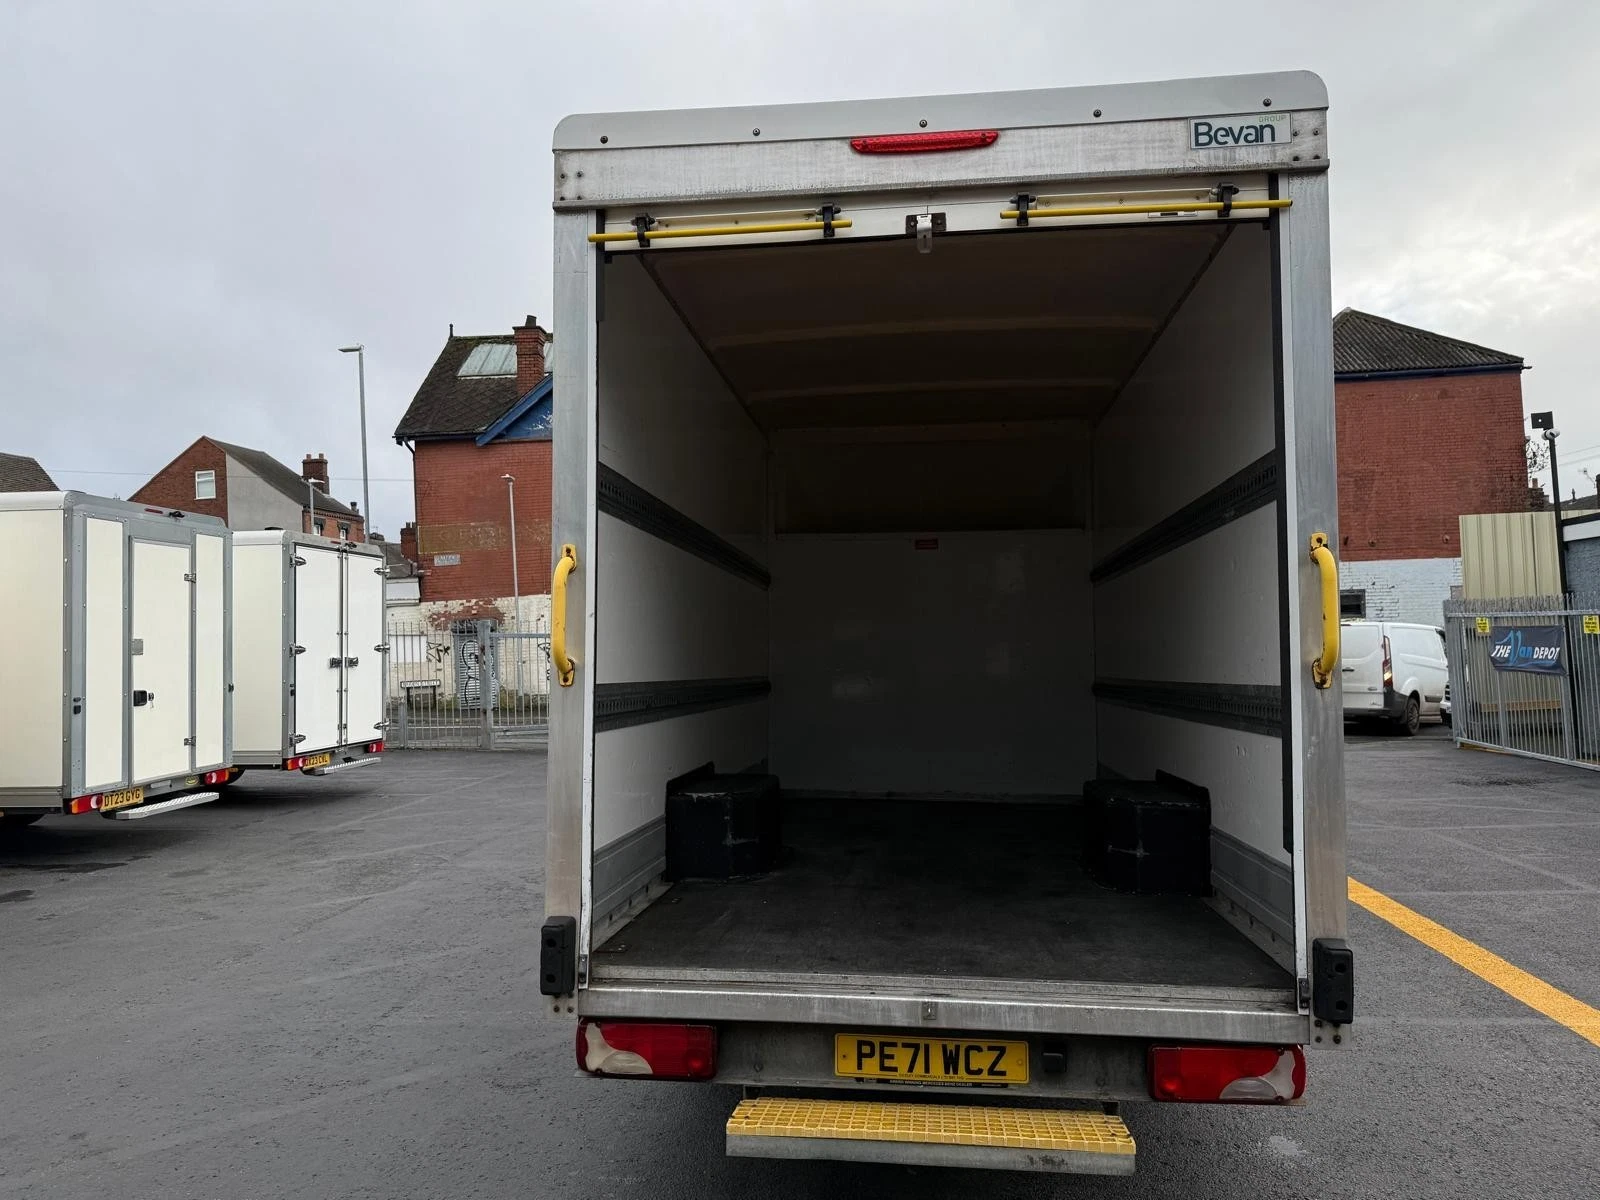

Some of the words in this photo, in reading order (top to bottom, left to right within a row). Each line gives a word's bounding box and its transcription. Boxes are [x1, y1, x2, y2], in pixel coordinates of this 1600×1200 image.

[1259, 114, 1287, 123] GROUP
[1194, 121, 1276, 147] Bevan
[1491, 645, 1511, 658] THE
[1533, 647, 1560, 660] DEPOT
[104, 793, 125, 807] DT23
[856, 1039, 931, 1074] PE71
[942, 1044, 1007, 1077] WCZ
